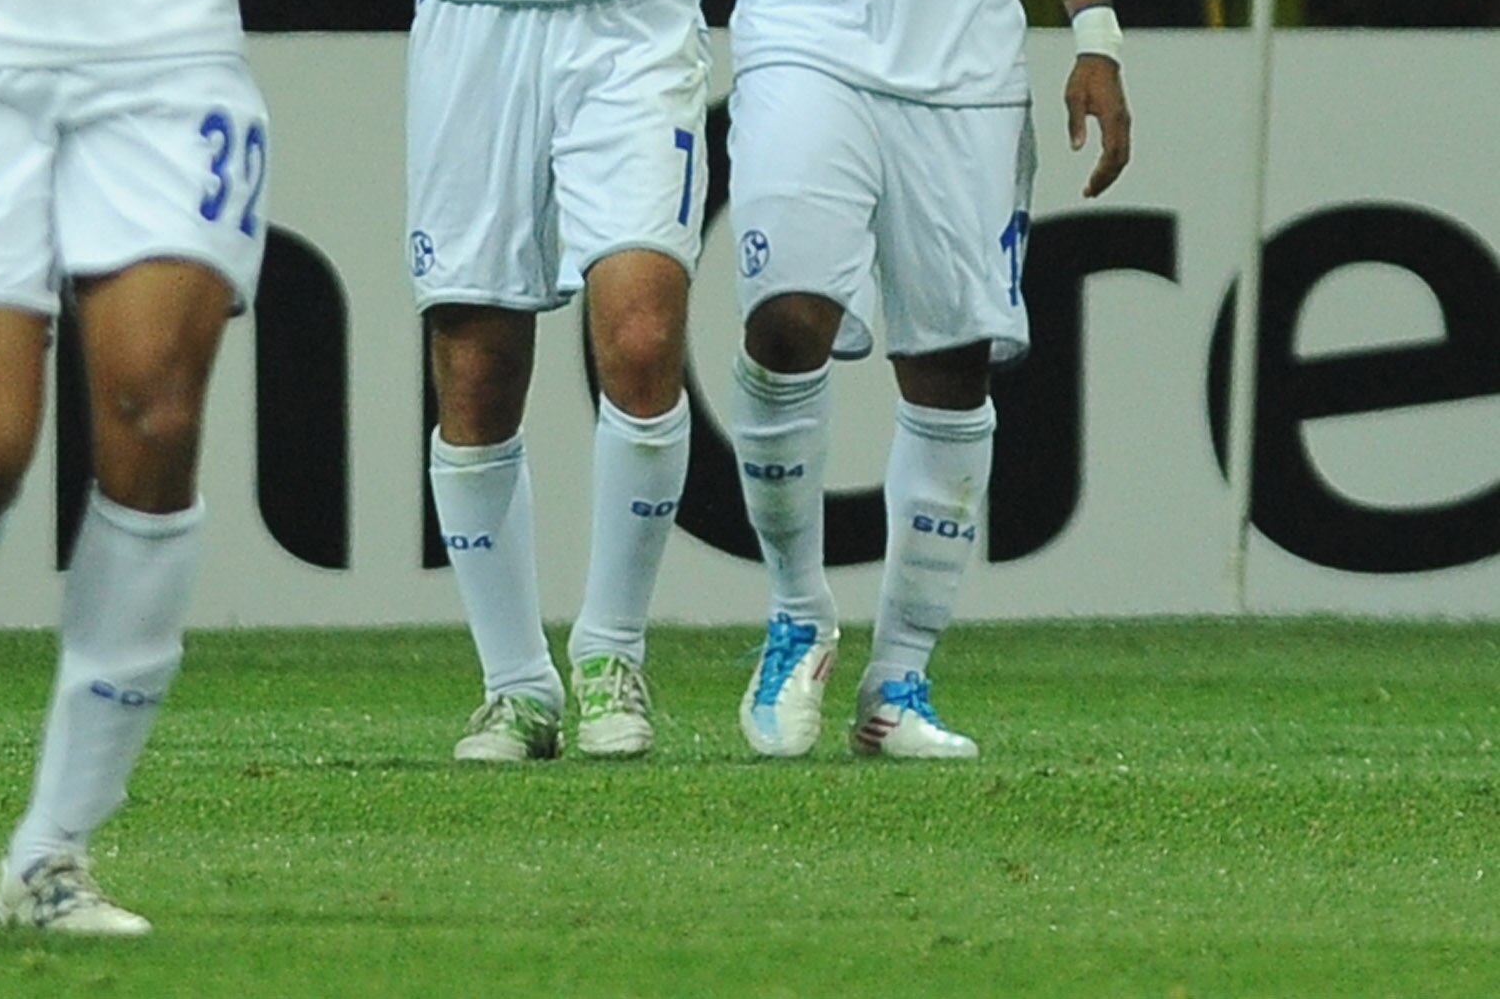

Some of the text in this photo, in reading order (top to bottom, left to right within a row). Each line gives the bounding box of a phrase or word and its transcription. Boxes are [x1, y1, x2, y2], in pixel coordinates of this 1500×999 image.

[199, 108, 266, 238] 32
[674, 127, 695, 226] 7
[912, 515, 976, 542] S04
